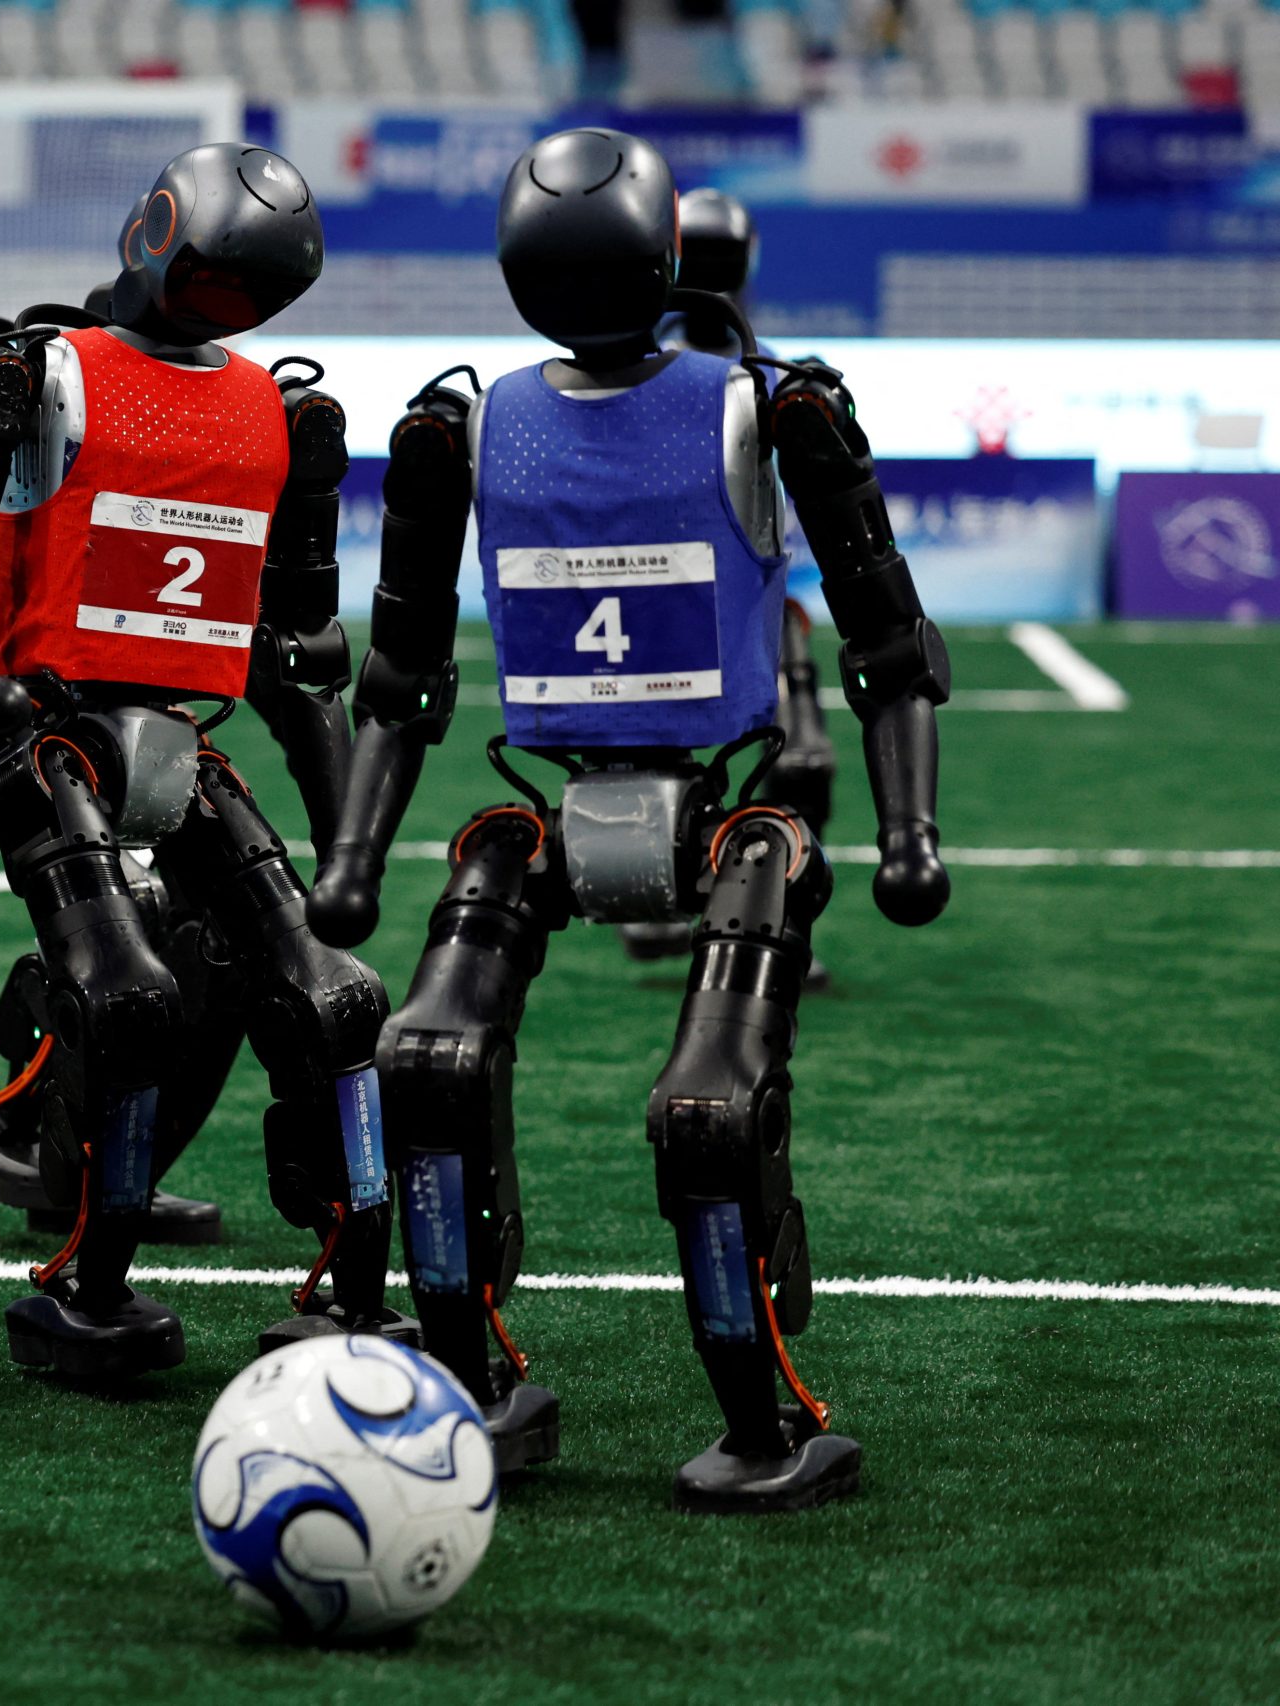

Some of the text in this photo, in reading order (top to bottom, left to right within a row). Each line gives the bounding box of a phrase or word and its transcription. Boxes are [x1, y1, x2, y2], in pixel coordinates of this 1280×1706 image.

[160, 508, 244, 527] 世界人形机器人运动会
[185, 522, 210, 530] Humanoid
[566, 555, 669, 569] 世界人形机器人运动会
[157, 546, 205, 607] 2
[575, 597, 630, 663] 4
